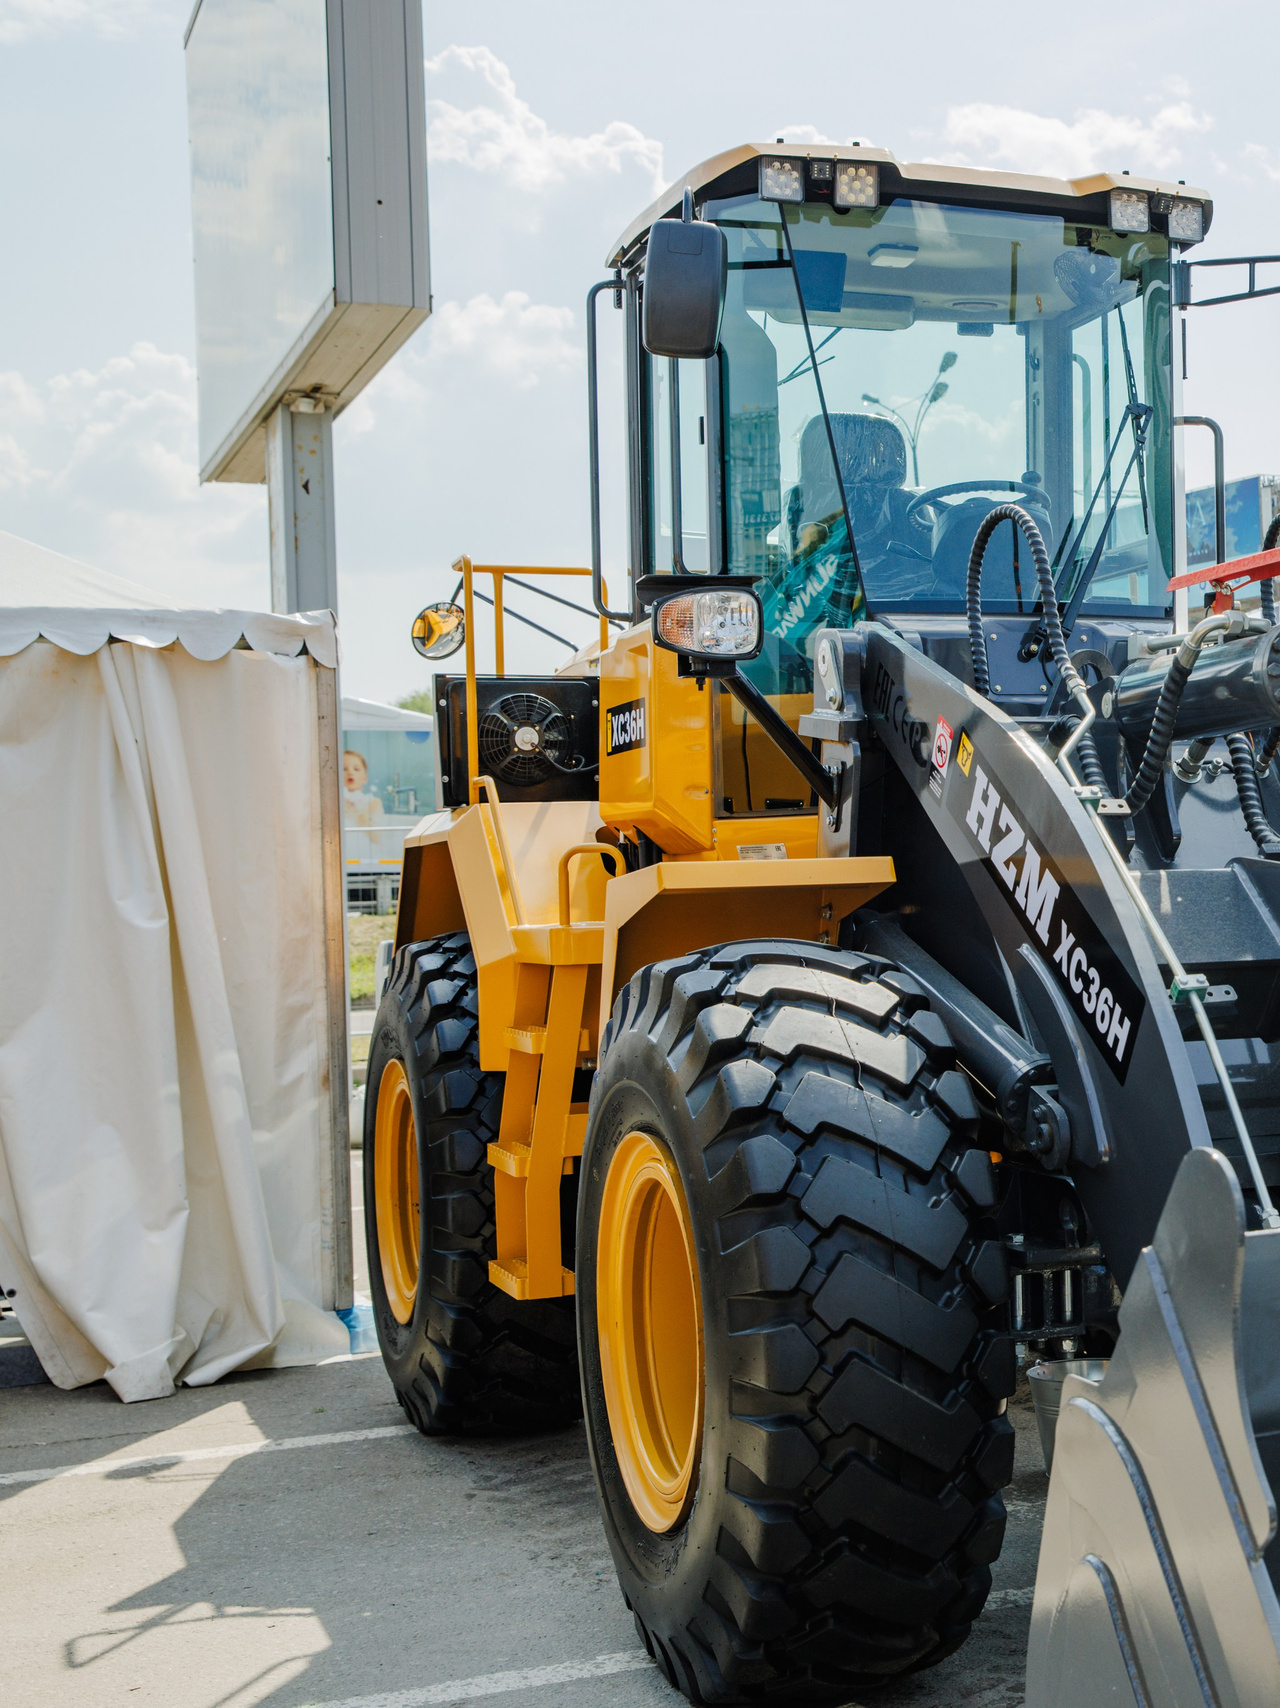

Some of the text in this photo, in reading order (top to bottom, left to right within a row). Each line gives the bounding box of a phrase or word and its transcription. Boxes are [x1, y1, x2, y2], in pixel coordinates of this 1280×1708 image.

[611, 707, 645, 748] XC36H
[966, 765, 1060, 946] HZM
[1053, 919, 1131, 1062] XC36H
